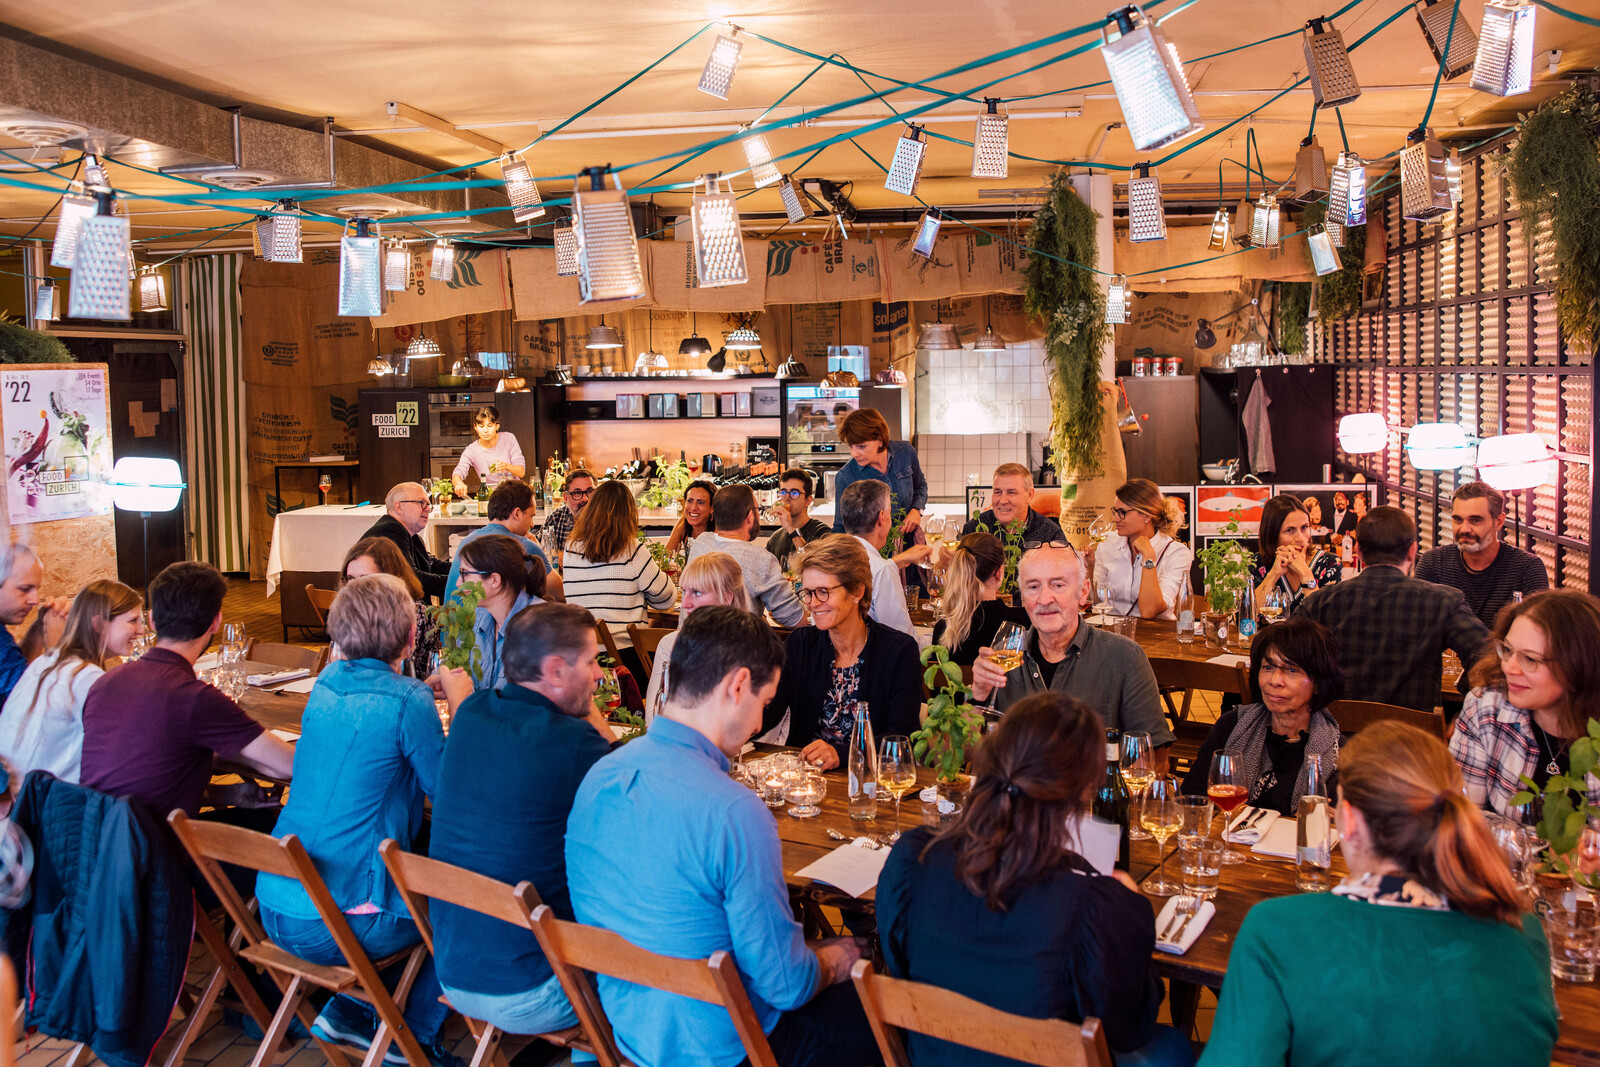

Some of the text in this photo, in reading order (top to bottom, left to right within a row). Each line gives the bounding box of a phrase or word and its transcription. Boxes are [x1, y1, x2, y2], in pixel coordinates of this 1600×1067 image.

[874, 306, 907, 326] soana
[374, 415, 394, 424] FOOD
[380, 427, 407, 436] ZURICH
[42, 472, 63, 481] FOOD
[49, 483, 77, 494] ZURICH
